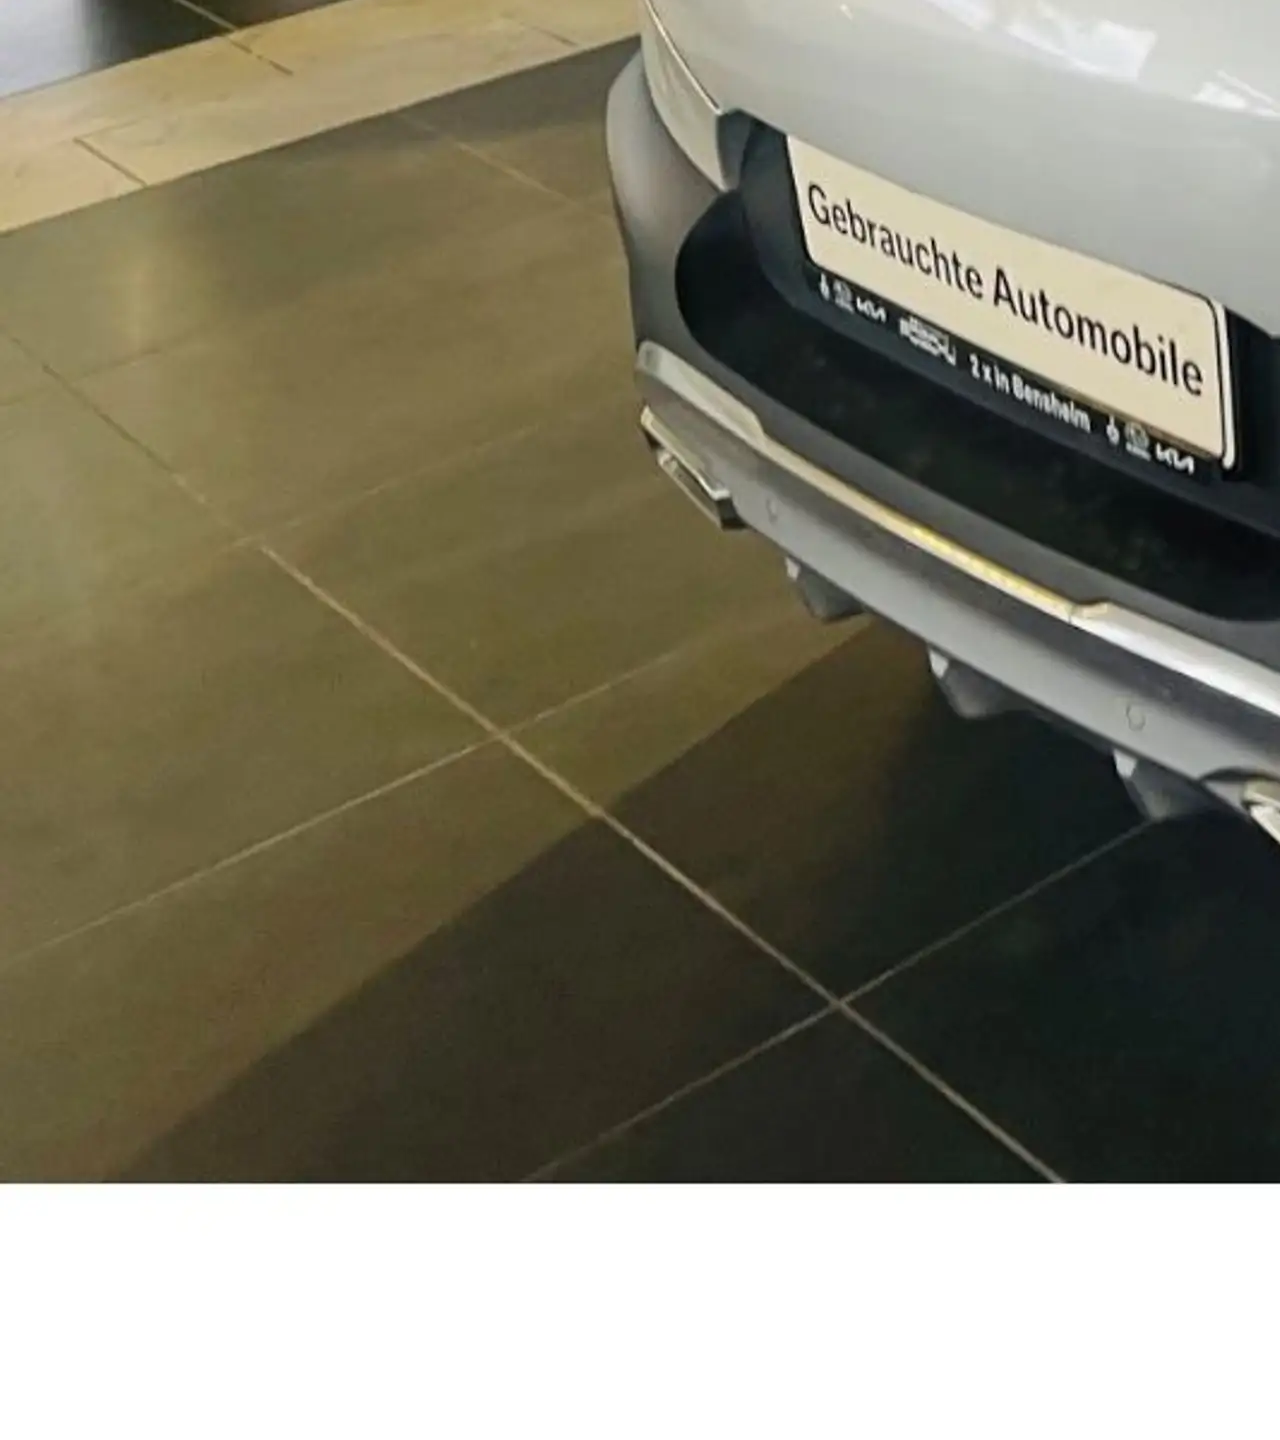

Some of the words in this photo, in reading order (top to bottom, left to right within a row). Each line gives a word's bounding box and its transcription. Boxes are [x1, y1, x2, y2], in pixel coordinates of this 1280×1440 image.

[807, 183, 984, 301] Gebrauchte
[992, 265, 1205, 398] Automobile
[969, 353, 982, 380] 2
[983, 362, 993, 387] x
[994, 366, 1010, 396] in
[1011, 373, 1092, 434] Bensheim
